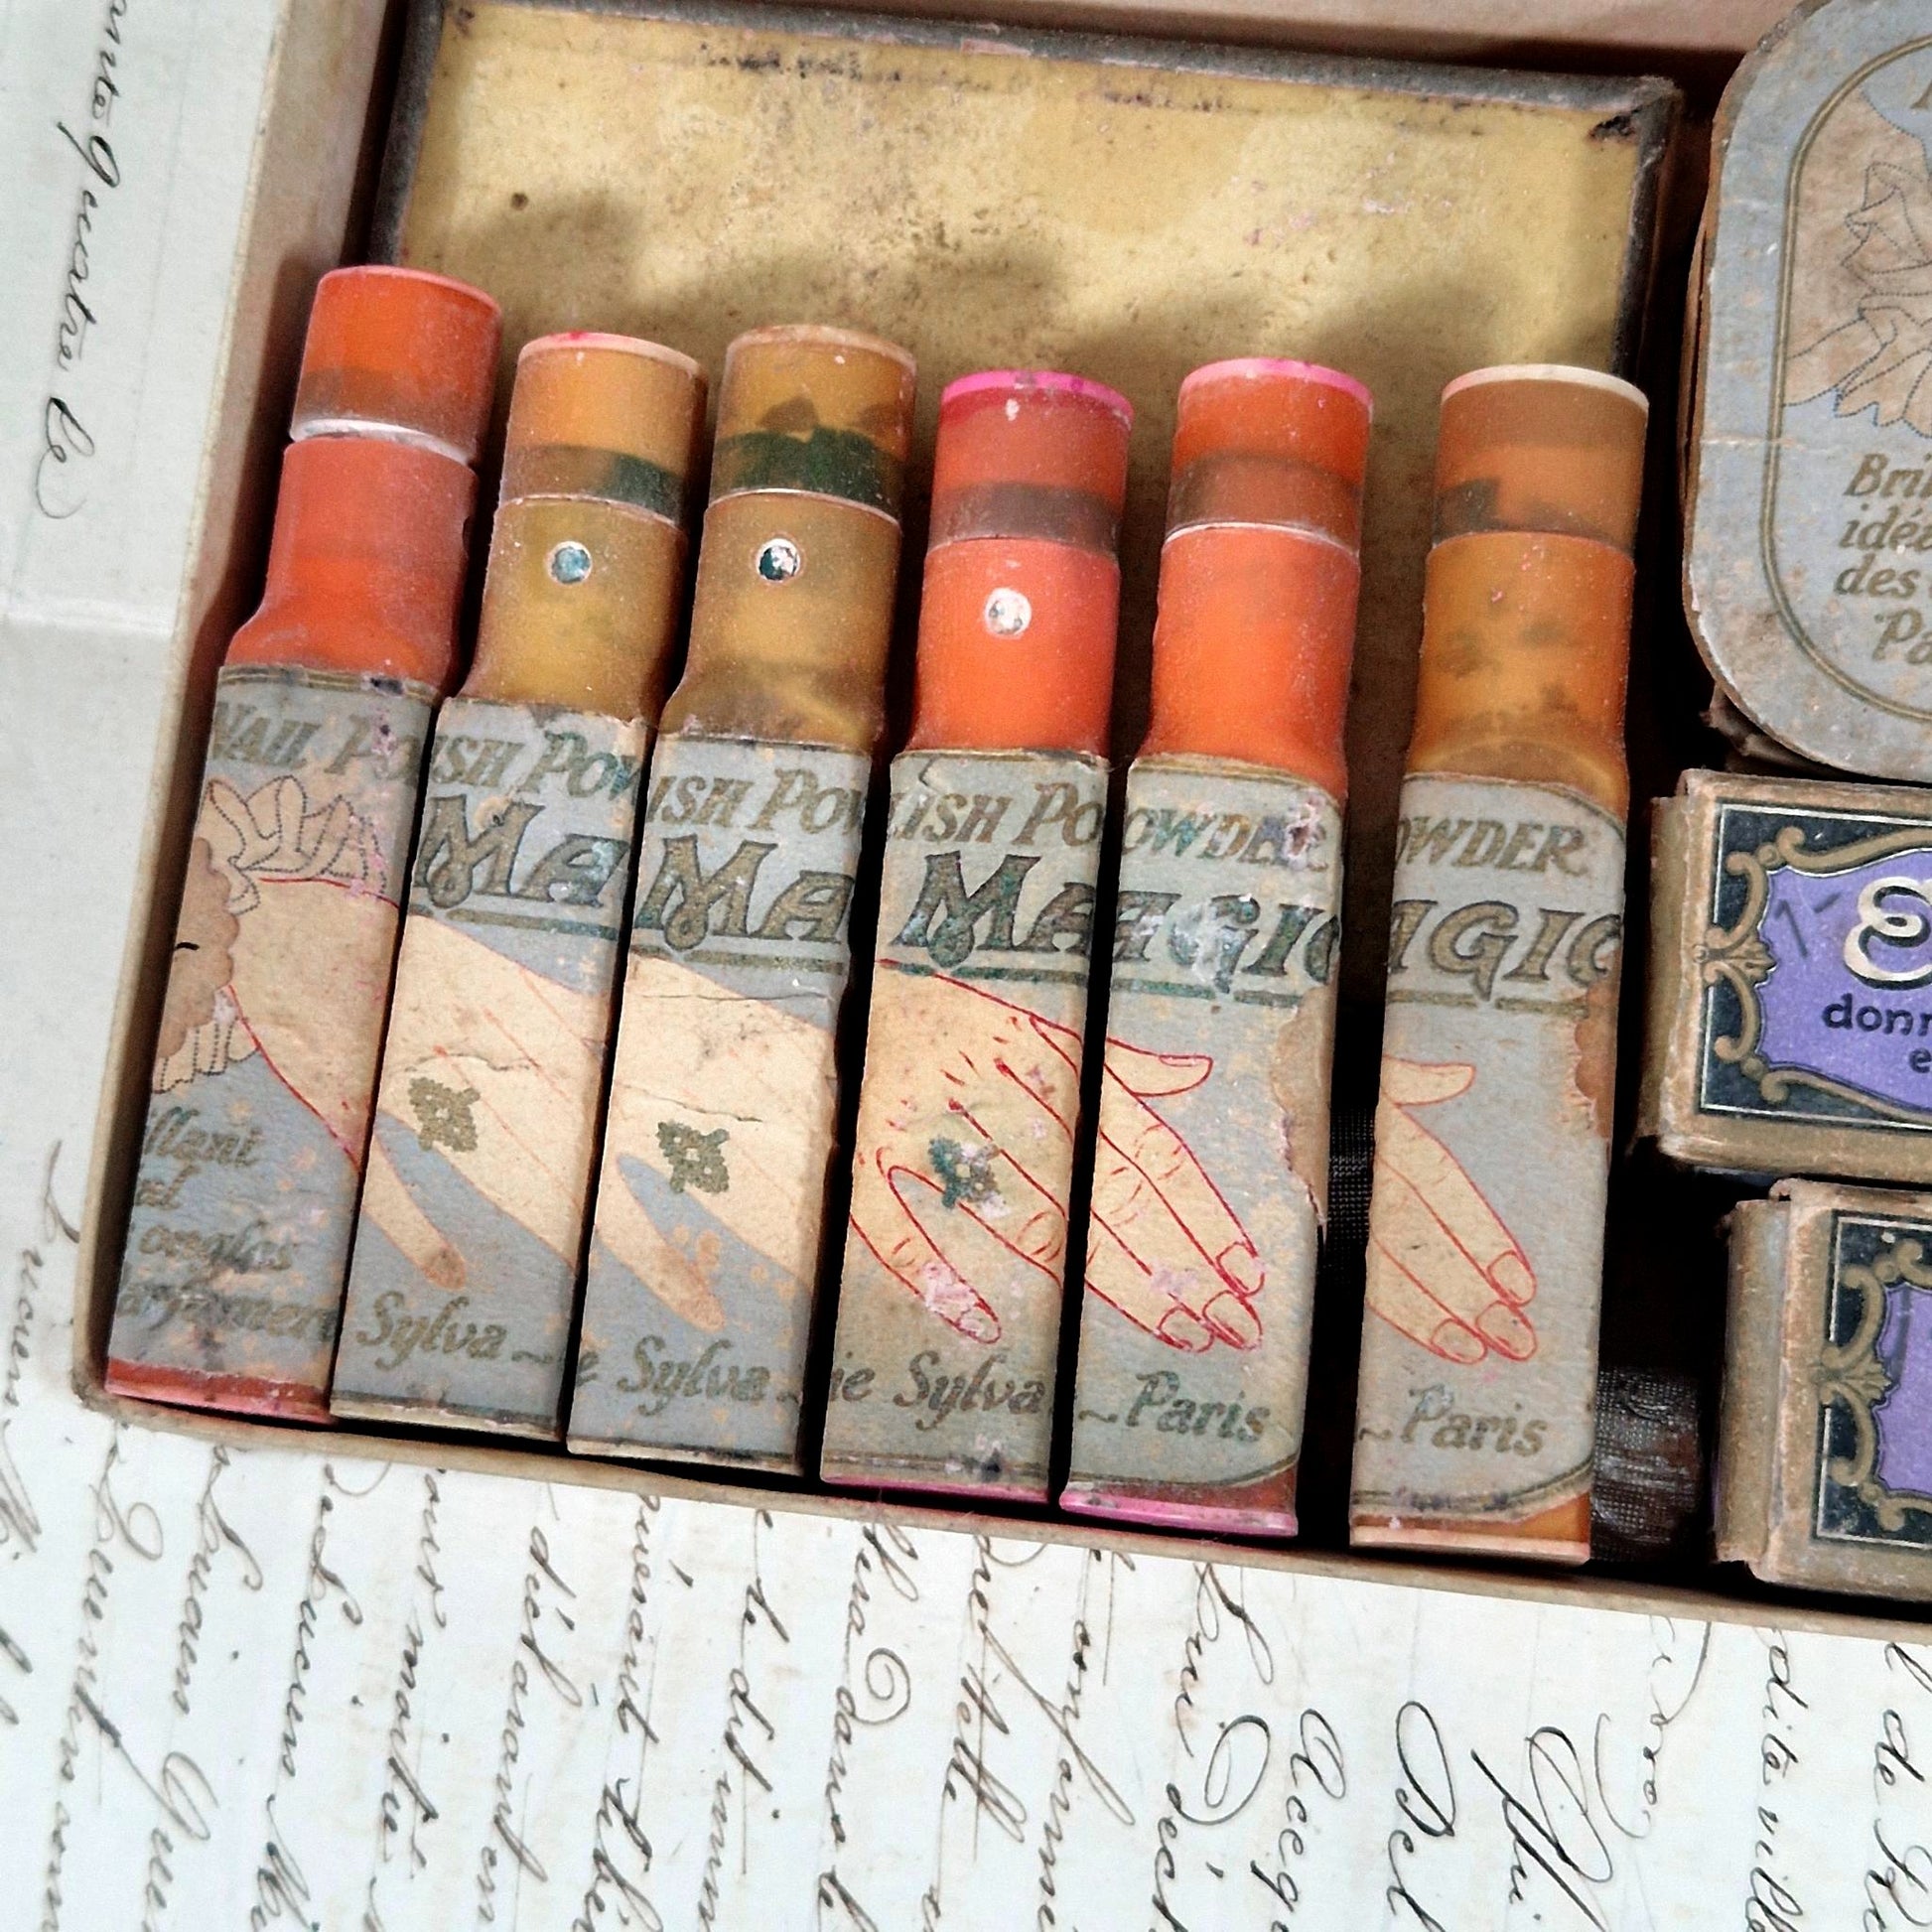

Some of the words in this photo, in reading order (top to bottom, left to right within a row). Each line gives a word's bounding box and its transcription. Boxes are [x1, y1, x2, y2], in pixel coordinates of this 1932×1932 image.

[1834, 552, 1920, 599] des
[356, 1292, 509, 1371] Sylva
[617, 1334, 770, 1417] Sylva
[894, 1350, 1046, 1431] Sylva
[1124, 1369, 1272, 1445] Paris
[1399, 1382, 1550, 1459] Paris
